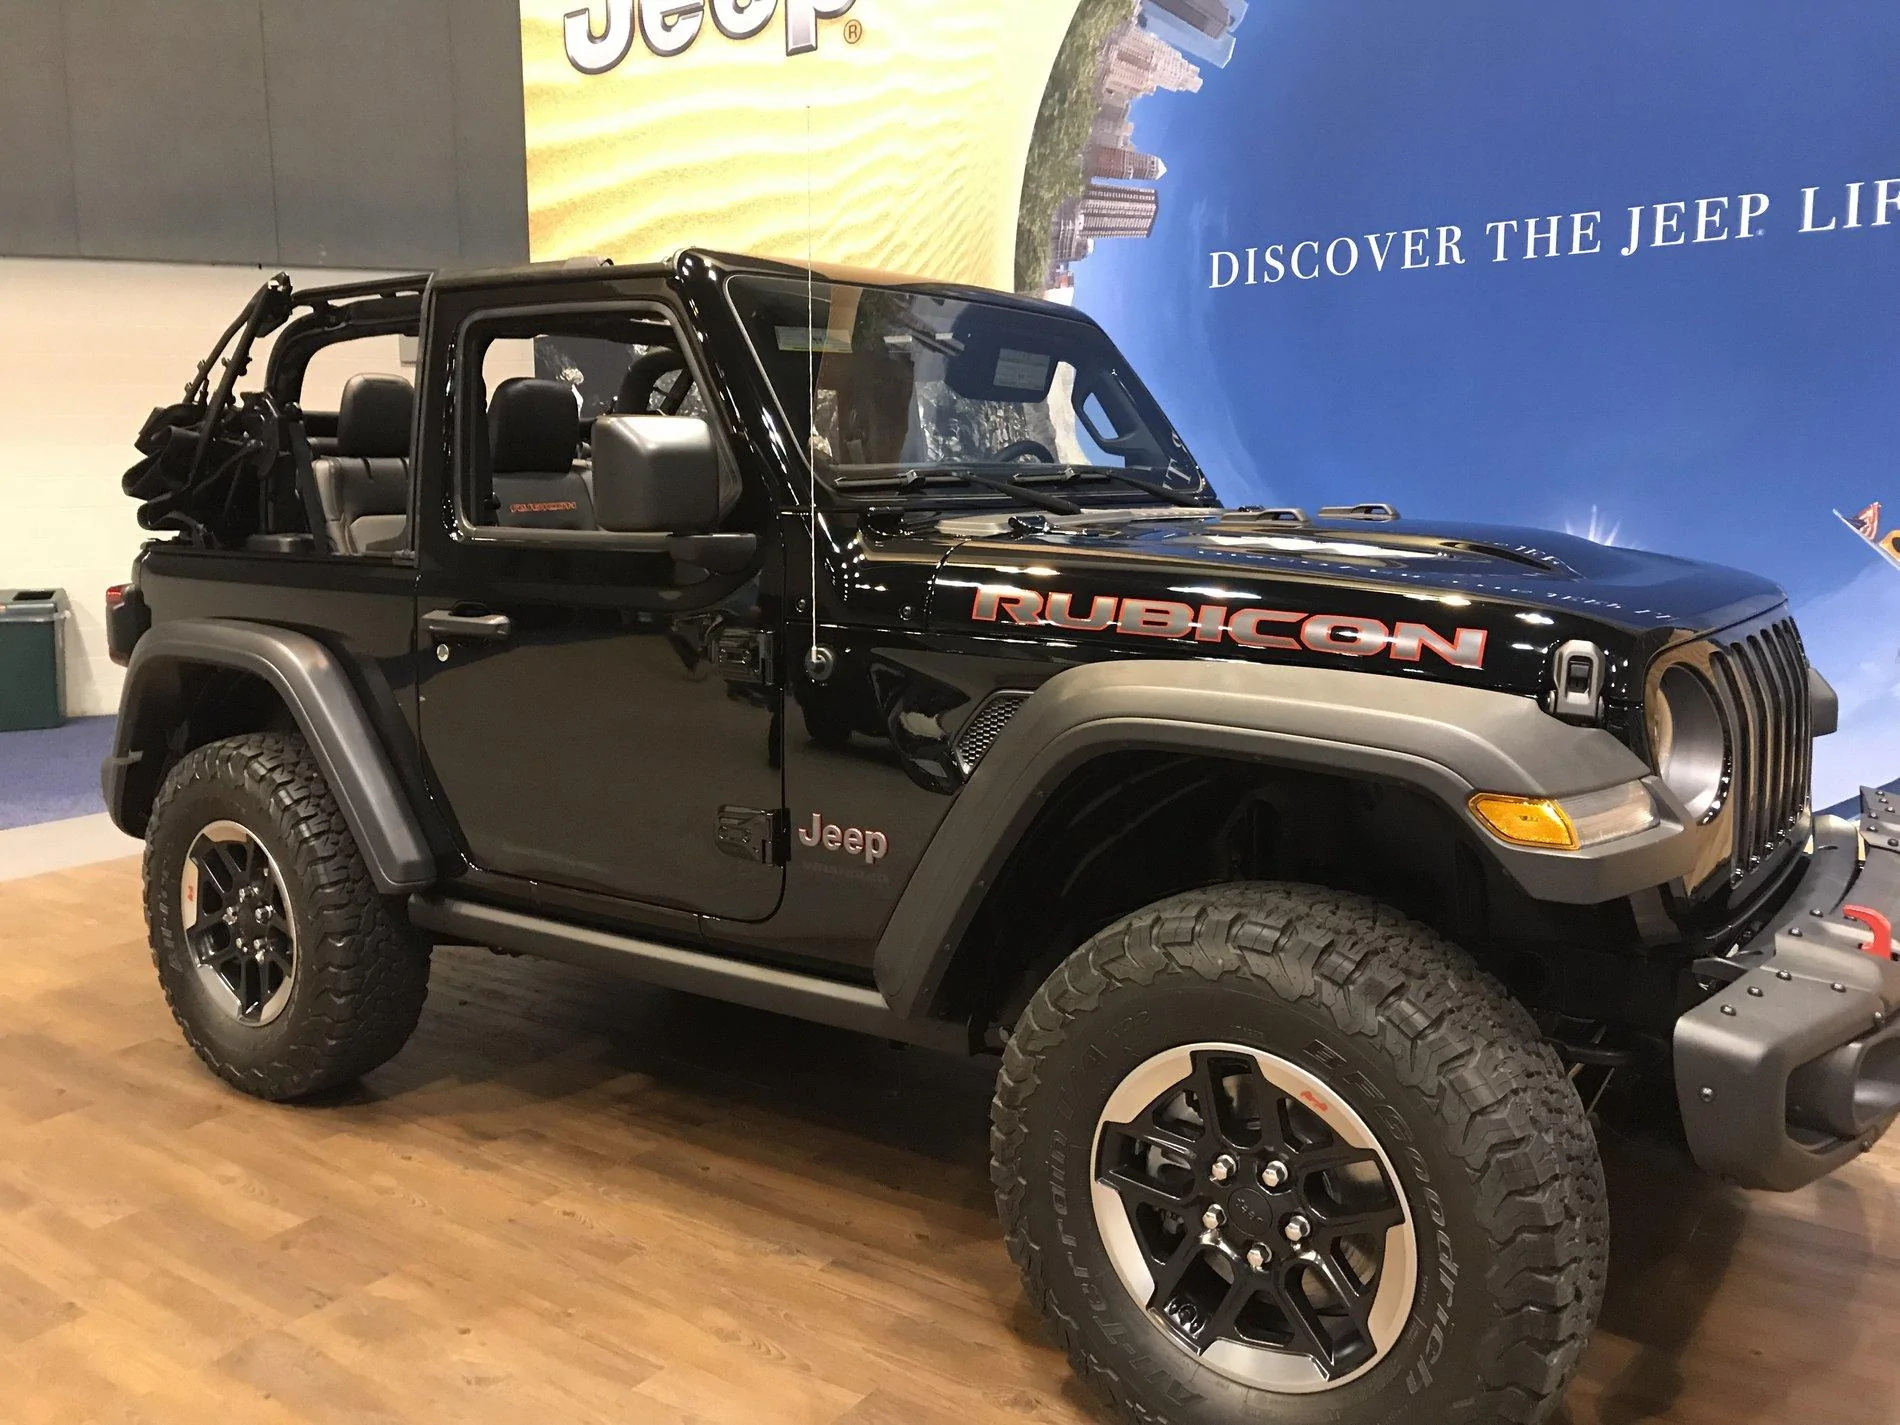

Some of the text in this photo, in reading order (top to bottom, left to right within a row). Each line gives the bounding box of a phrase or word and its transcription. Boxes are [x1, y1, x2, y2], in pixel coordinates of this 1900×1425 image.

[1208, 225, 1466, 289] DISCOVER
[1485, 210, 1602, 262] THE
[1620, 192, 1770, 257] JEEP
[972, 584, 1488, 670] RUBICON
[798, 812, 888, 864] Jeep
